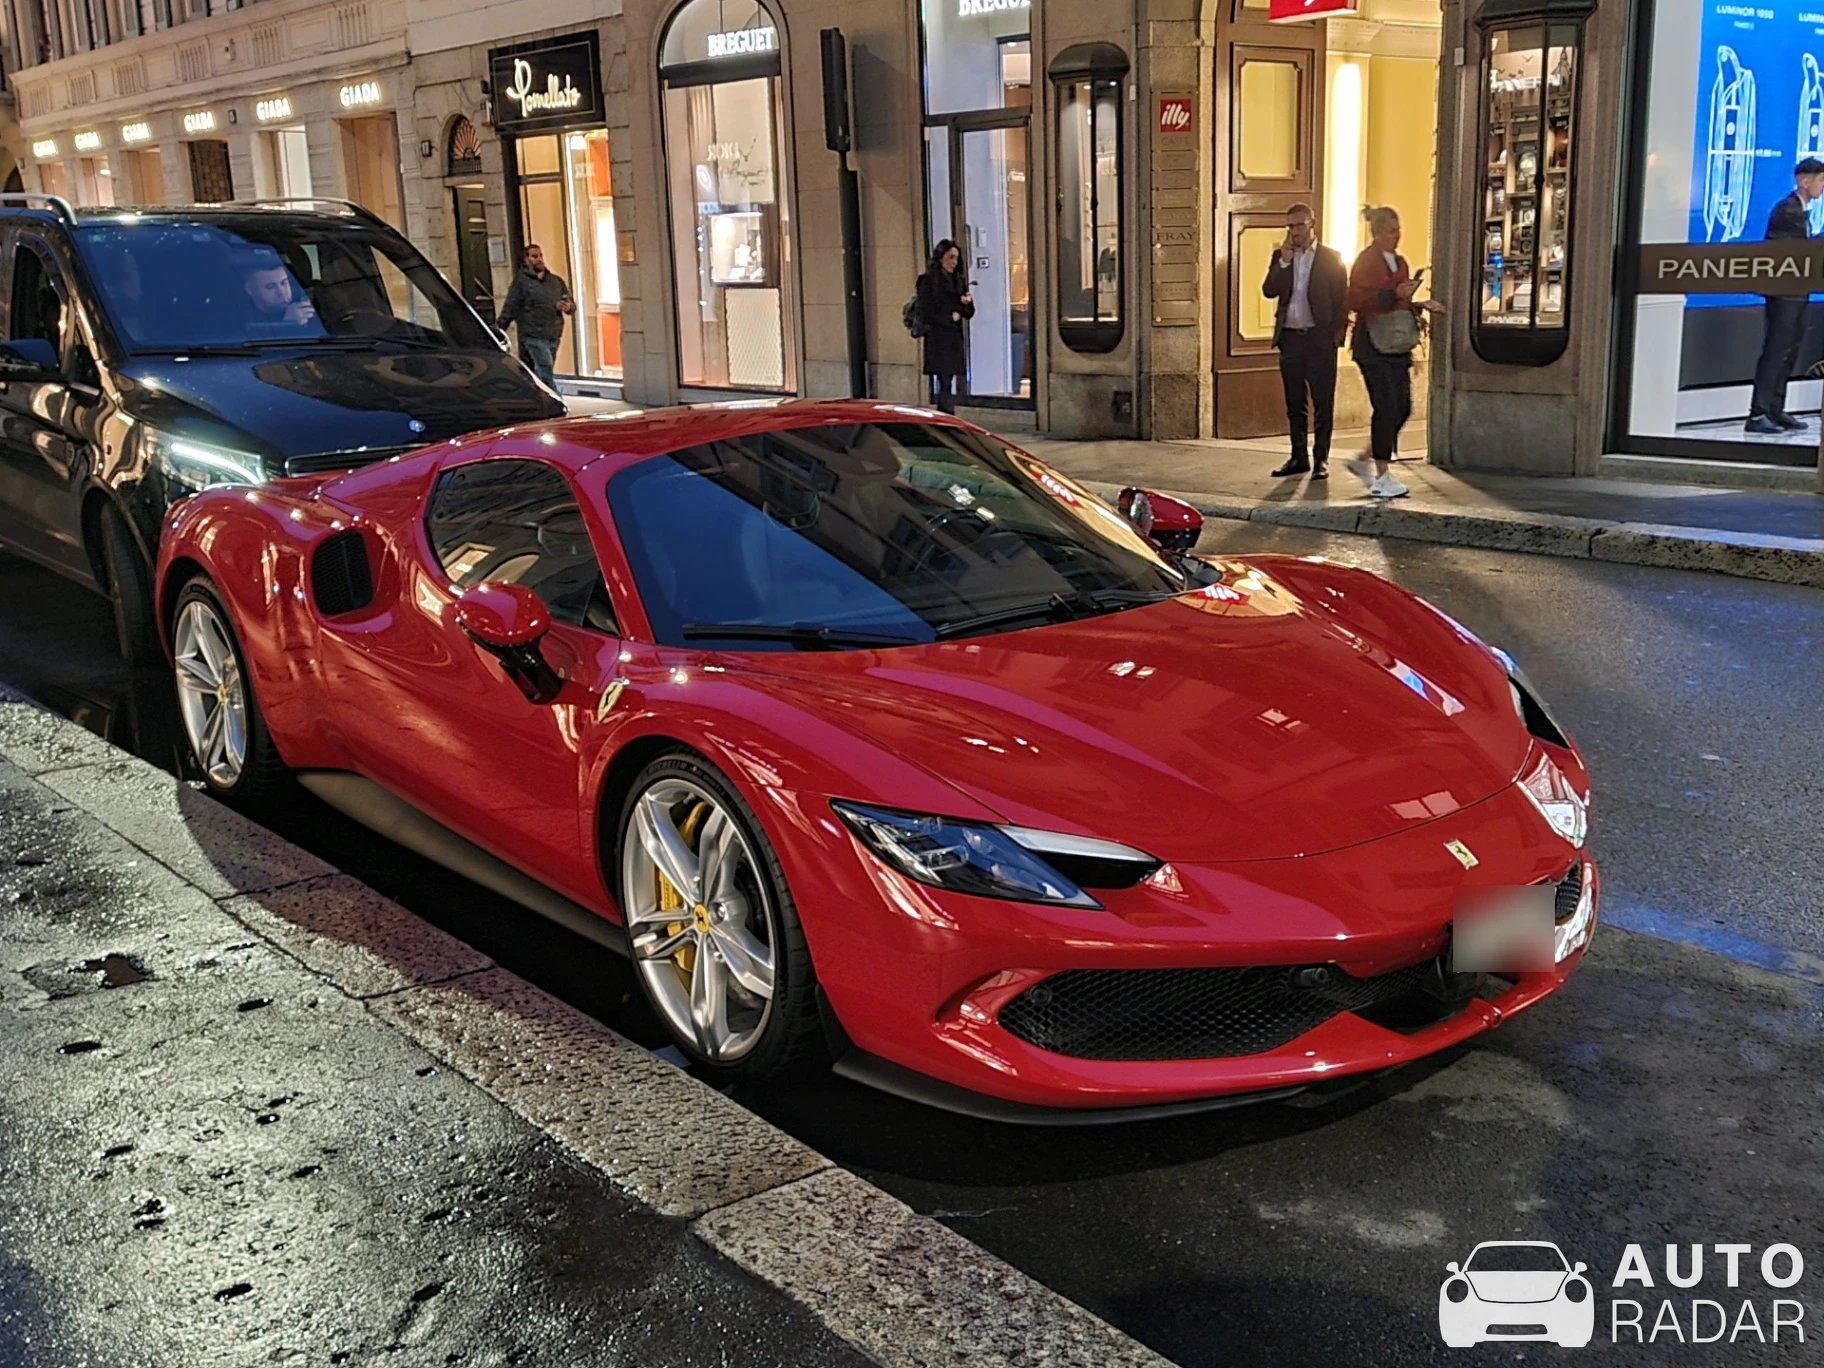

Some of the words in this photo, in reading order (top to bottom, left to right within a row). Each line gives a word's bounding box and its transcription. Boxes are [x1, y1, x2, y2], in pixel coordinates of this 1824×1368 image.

[707, 26, 774, 56] BREGUET
[339, 81, 381, 108] GIADA
[505, 58, 581, 117] Pomellato
[183, 110, 216, 133] GIADA
[256, 97, 292, 121] GIADA
[1161, 103, 1190, 130] illy
[1156, 231, 1196, 241] FRAY
[1657, 256, 1811, 279] PANERAI
